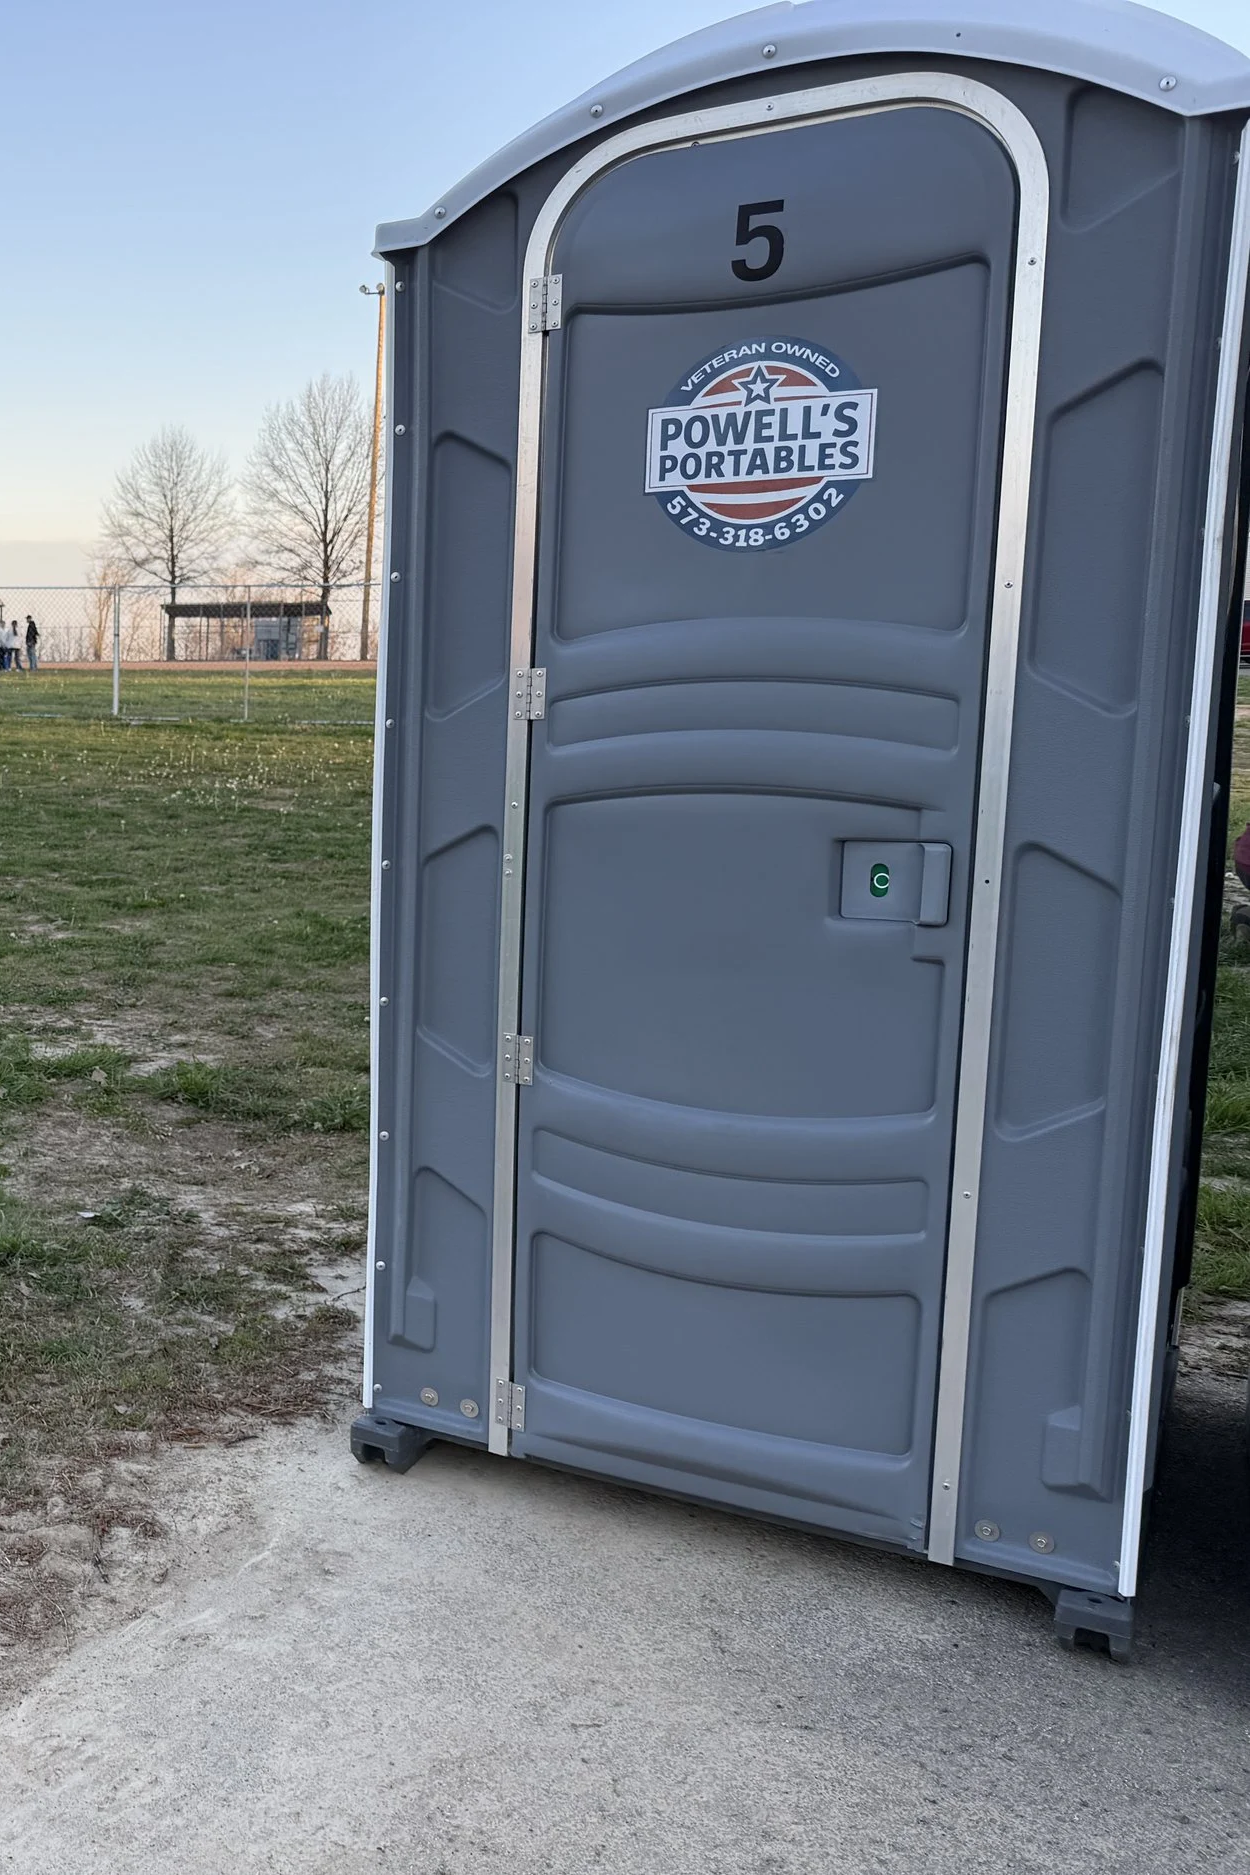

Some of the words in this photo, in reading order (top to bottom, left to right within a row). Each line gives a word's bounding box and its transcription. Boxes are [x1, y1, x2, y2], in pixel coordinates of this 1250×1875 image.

[731, 199, 784, 282] 5
[680, 342, 766, 393] VETERAN
[771, 341, 840, 378] OWNED
[660, 401, 859, 451] POWELL'S
[658, 440, 860, 482] PORTABLES
[666, 487, 845, 547] 573-318-6302
